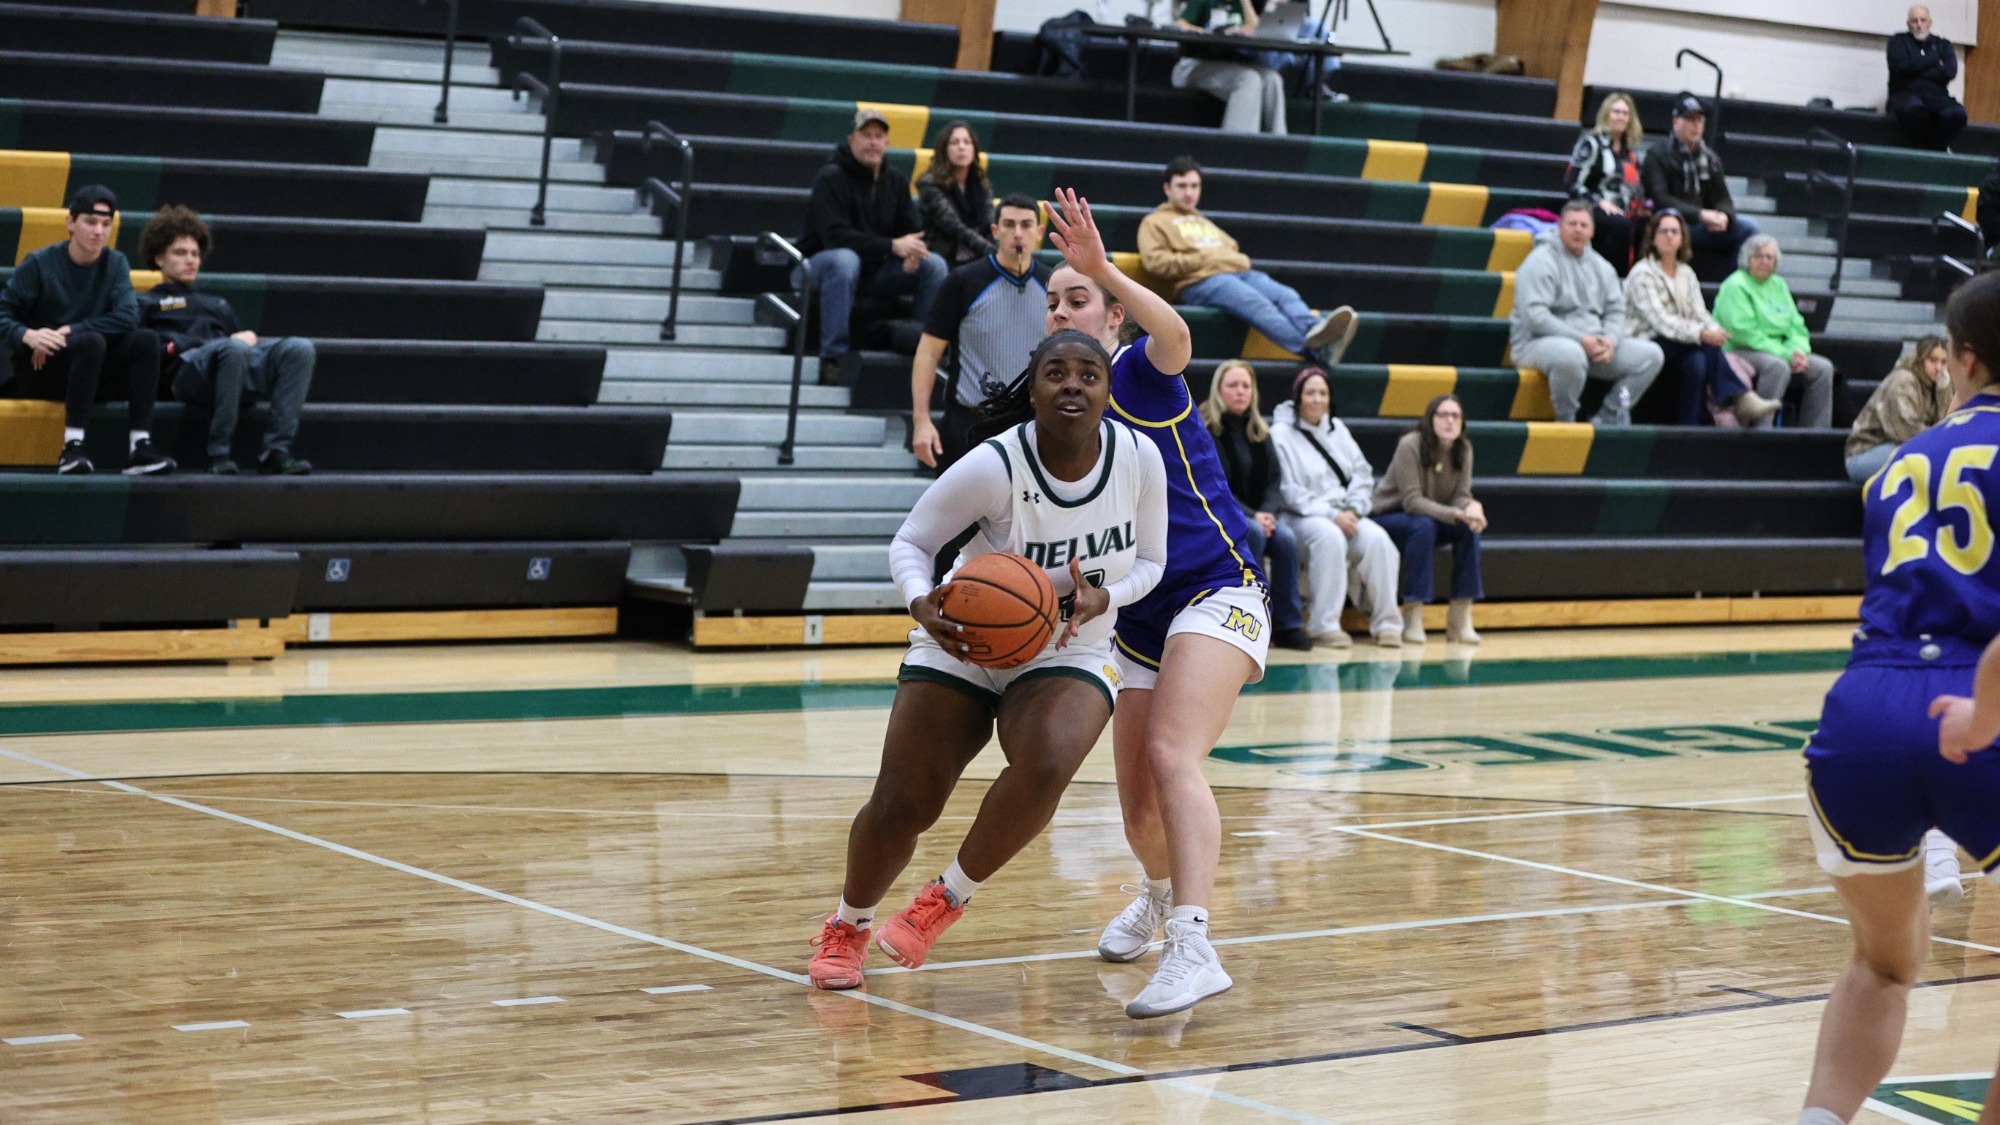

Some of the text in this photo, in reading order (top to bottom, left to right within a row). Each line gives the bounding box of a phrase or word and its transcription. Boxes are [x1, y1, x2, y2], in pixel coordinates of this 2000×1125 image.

[1880, 444, 1999, 576] 25
[1024, 521, 1136, 570] DELVAL
[1221, 605, 1263, 642] MU
[1207, 720, 1818, 777] GIES
